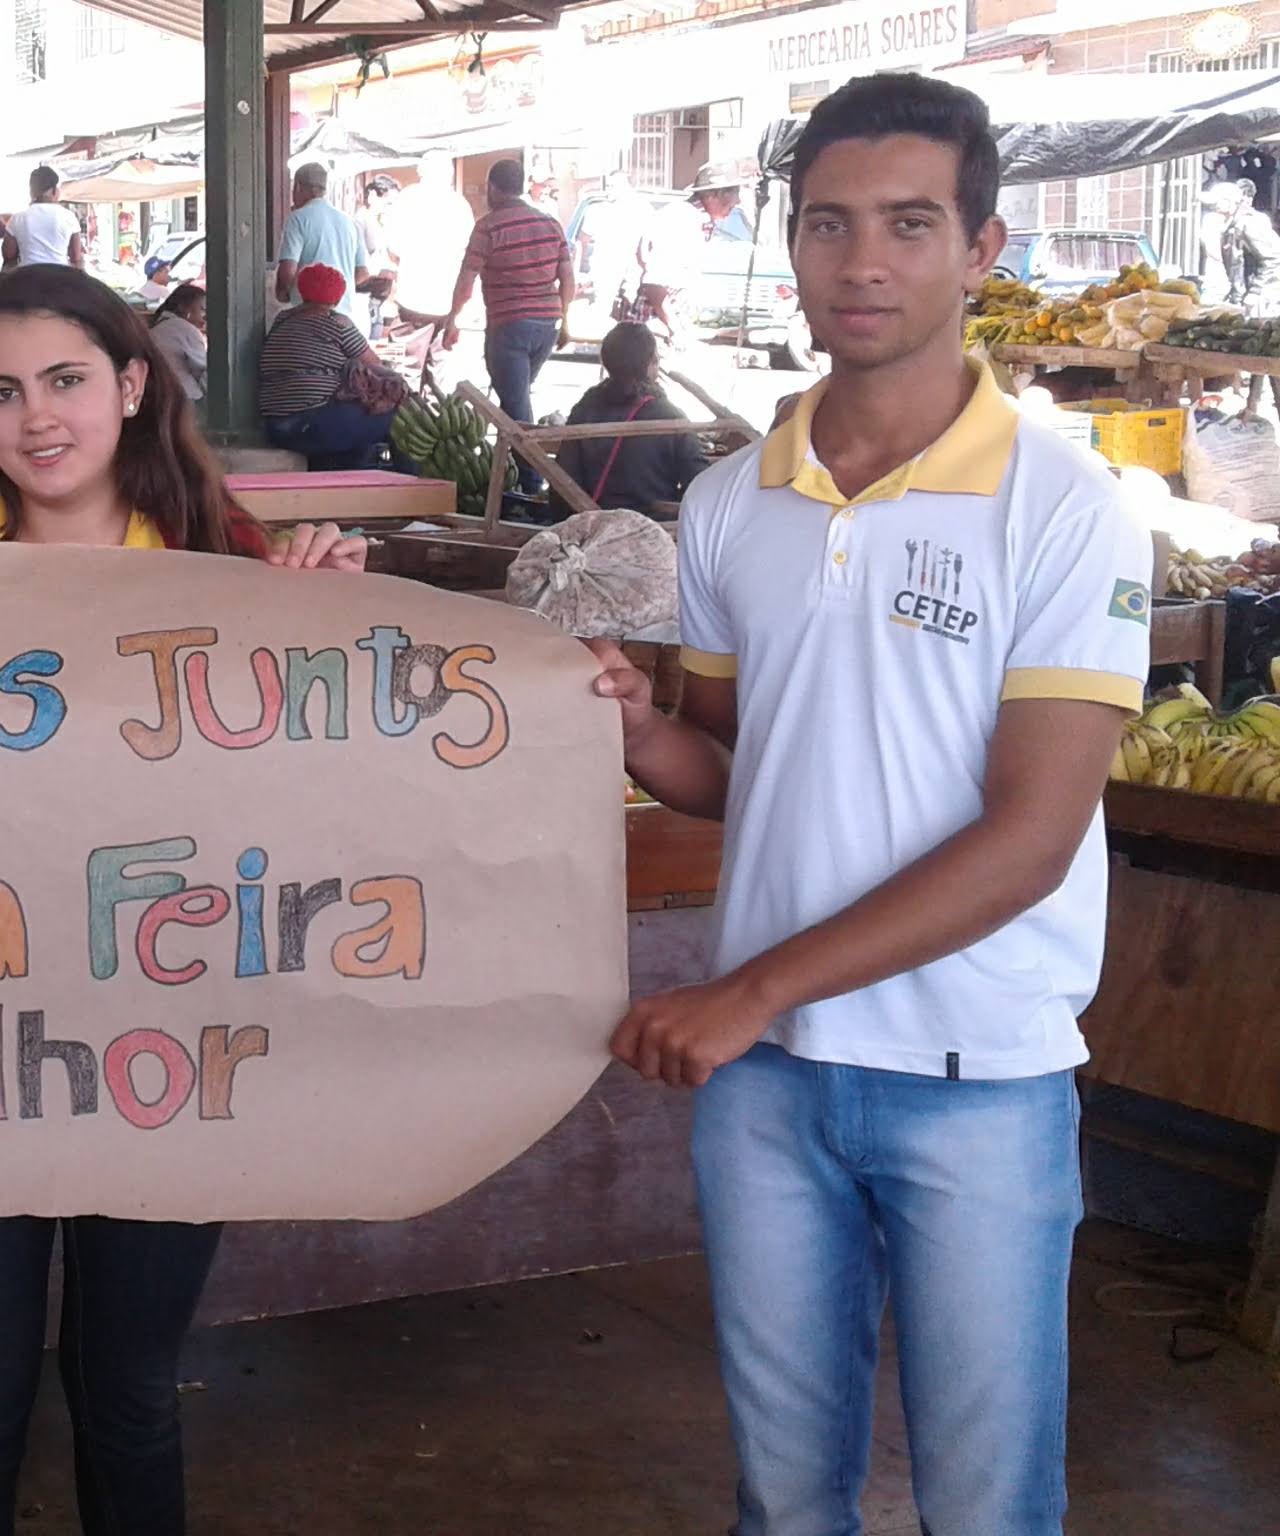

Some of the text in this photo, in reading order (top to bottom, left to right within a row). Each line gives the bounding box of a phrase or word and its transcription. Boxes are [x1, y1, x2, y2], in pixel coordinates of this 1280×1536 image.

[768, 4, 958, 72] MERCEARIA SOARES
[893, 590, 979, 634] CETEP
[86, 836, 427, 985] Feira
